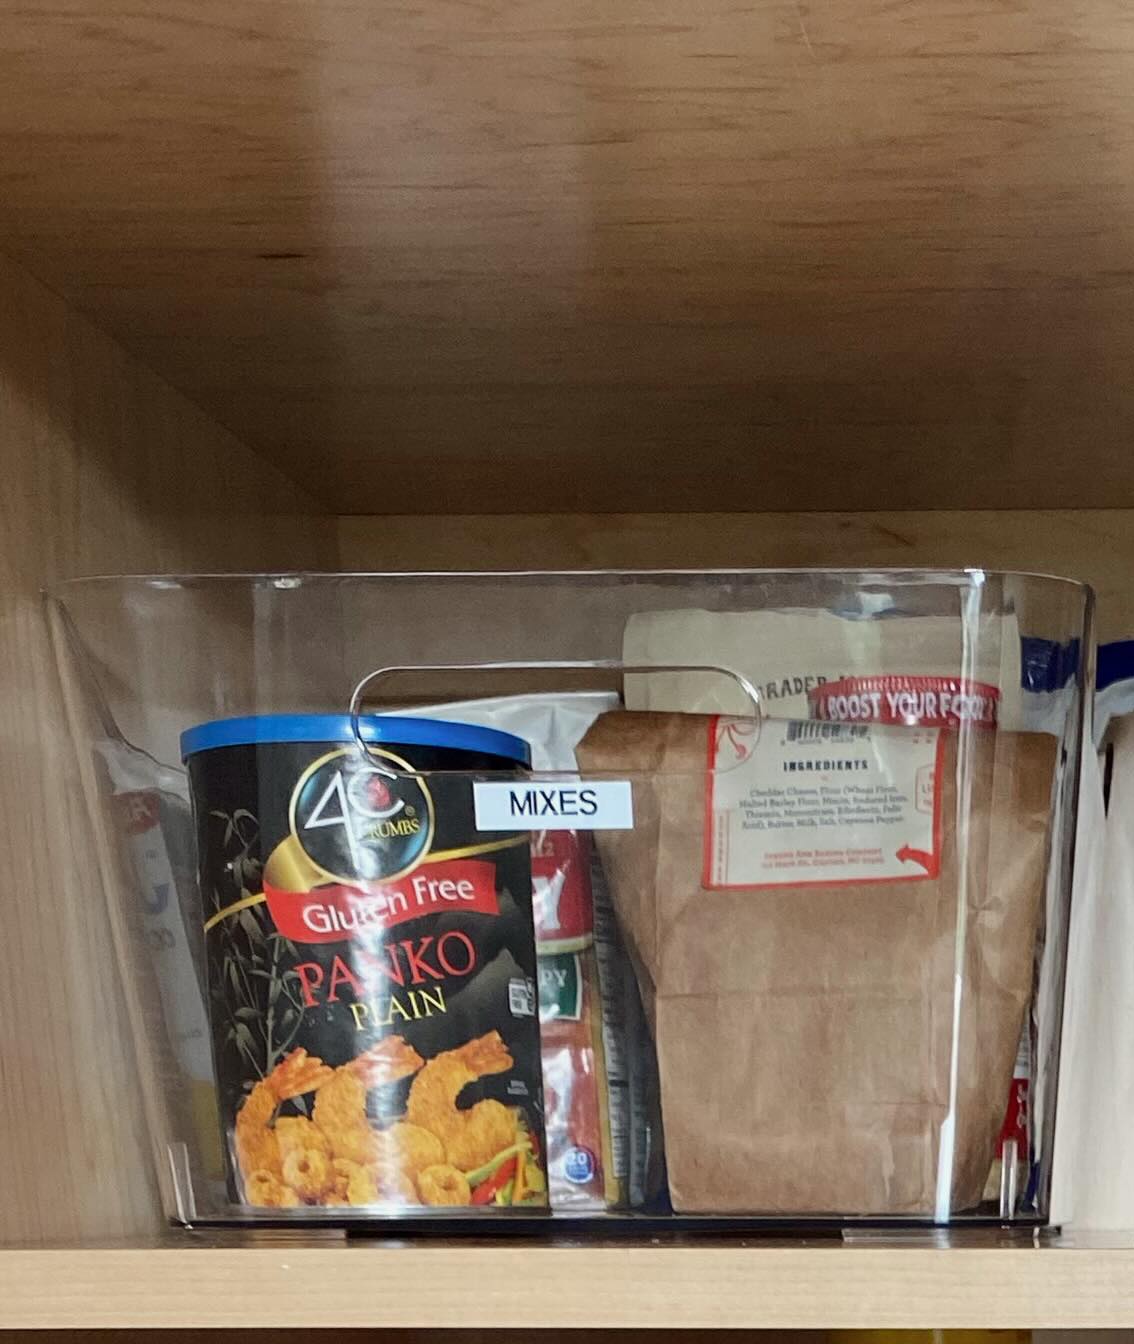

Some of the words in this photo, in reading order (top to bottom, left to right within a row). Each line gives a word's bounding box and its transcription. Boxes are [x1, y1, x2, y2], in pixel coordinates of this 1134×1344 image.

[826, 692, 881, 720] BOOST
[887, 691, 937, 719] YOUR
[783, 760, 869, 772] INGREDIENTS
[510, 790, 599, 816] MIXES
[303, 890, 408, 933] Gluten
[412, 876, 475, 907] Free
[293, 930, 477, 1008] PANKO
[350, 986, 448, 1031] PLAIN
